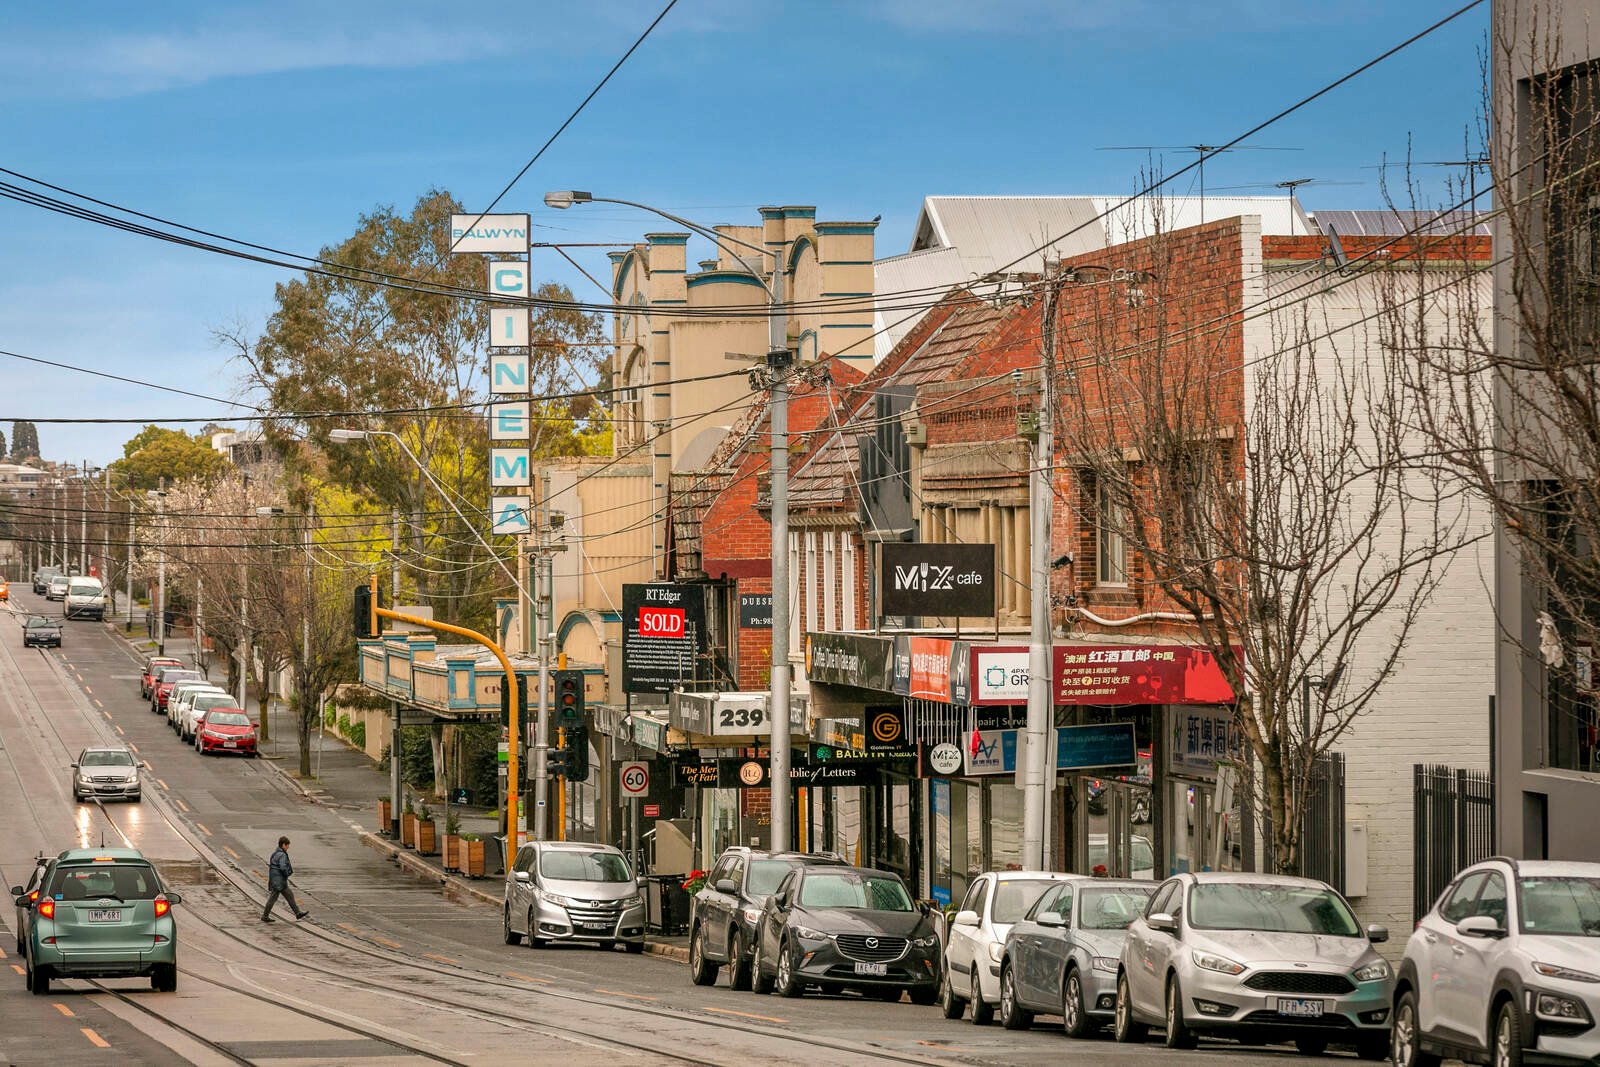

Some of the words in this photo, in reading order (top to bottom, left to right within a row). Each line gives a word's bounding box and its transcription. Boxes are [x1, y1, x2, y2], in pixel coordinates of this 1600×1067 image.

[453, 229, 526, 239] BALWYN
[494, 269, 528, 526] CINEMA
[957, 570, 983, 585] cafe
[646, 589, 658, 601] RT
[659, 589, 682, 605] Edgar
[643, 613, 682, 633] SOLD
[720, 709, 764, 727] 239
[682, 766, 698, 774] The
[939, 761, 953, 769] cafe
[626, 772, 644, 786] 60
[688, 774, 698, 784] of
[823, 767, 856, 778] Letters
